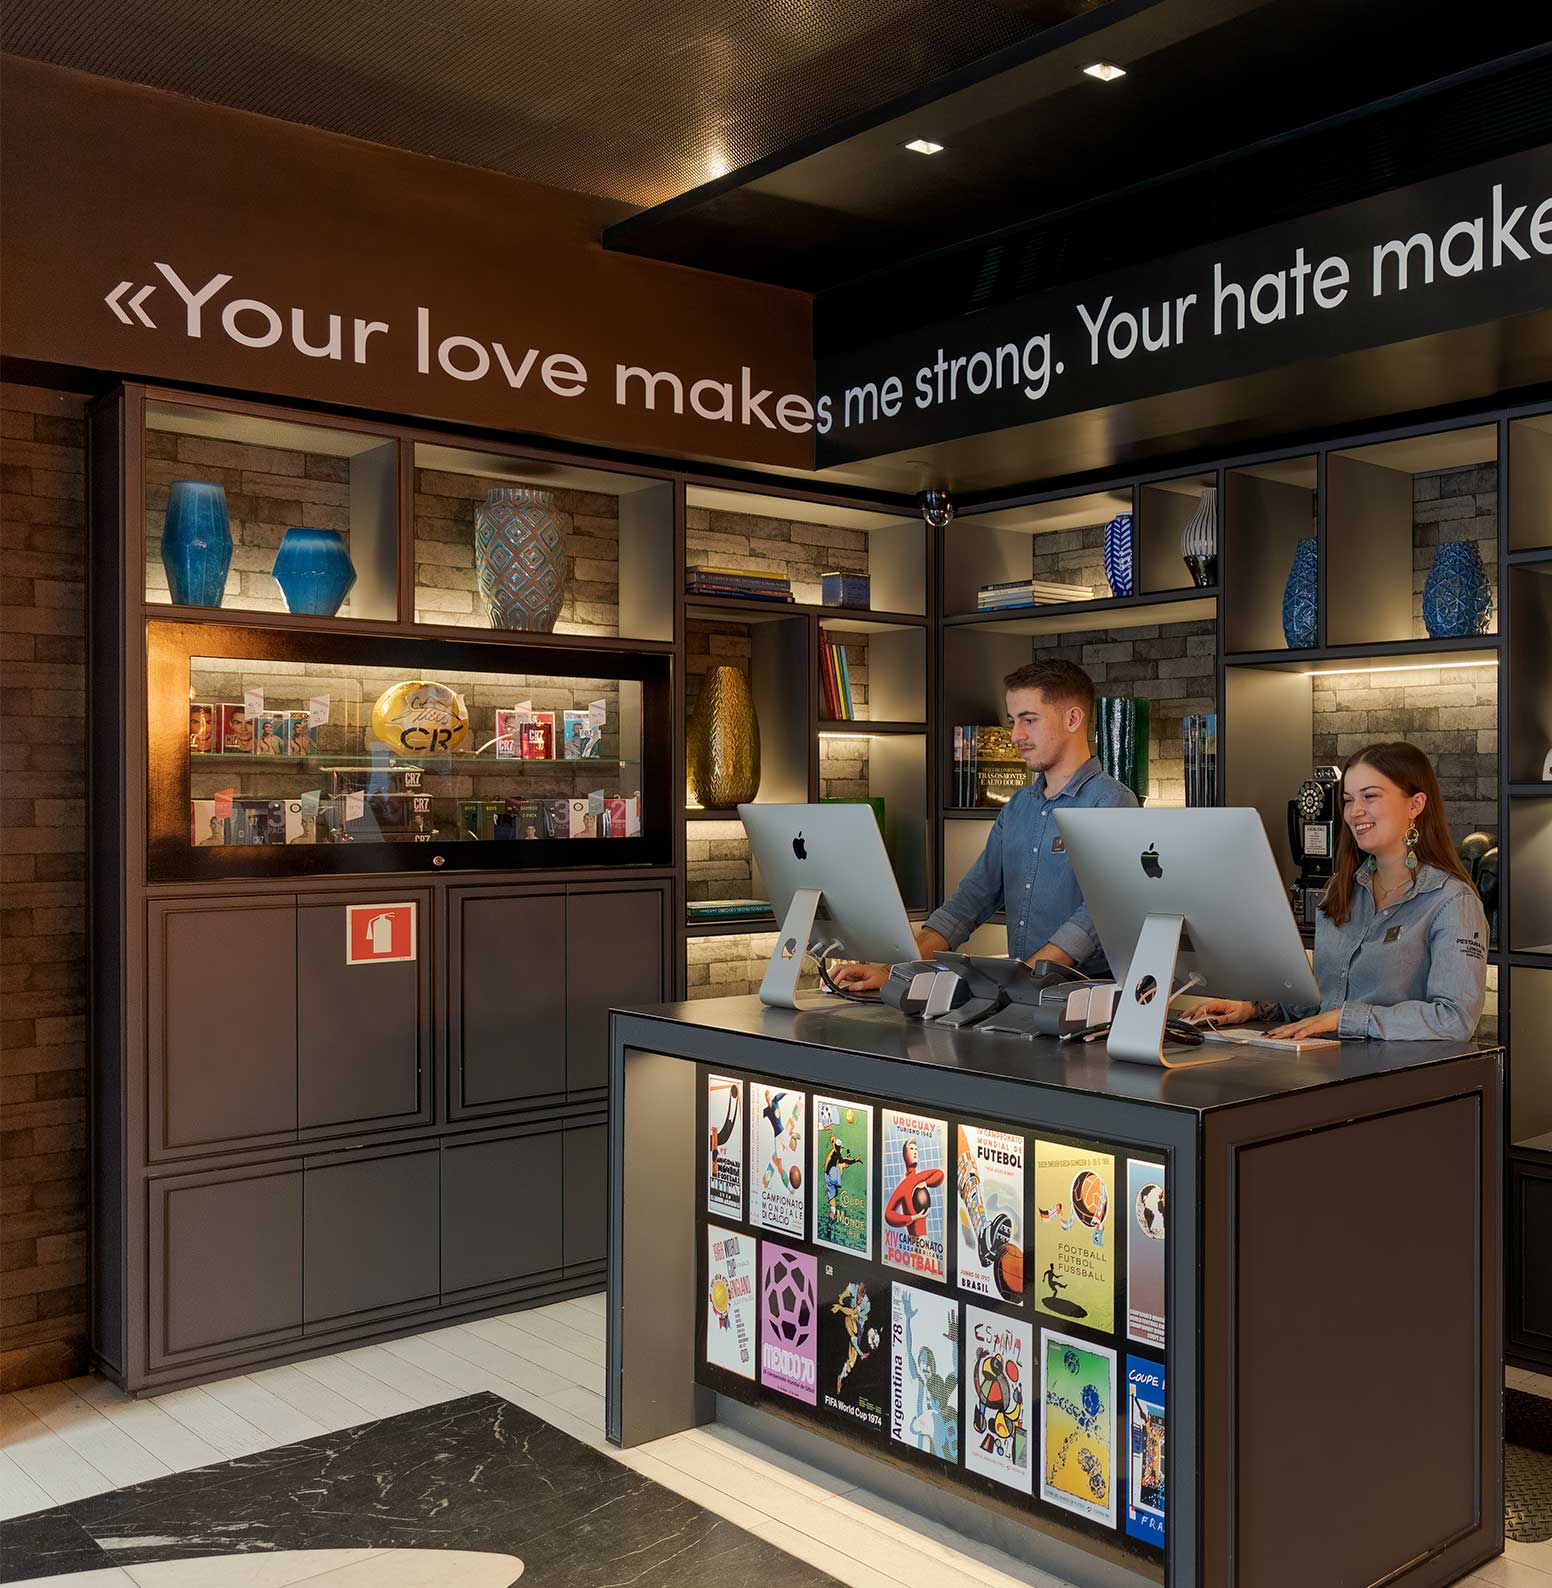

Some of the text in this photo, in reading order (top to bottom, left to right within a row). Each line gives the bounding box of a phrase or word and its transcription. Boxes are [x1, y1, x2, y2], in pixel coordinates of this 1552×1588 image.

[104, 261, 390, 365] «Your
[417, 306, 587, 397] love
[615, 364, 834, 434] makes
[844, 376, 903, 428] me
[915, 333, 1065, 409] strong.
[1077, 293, 1197, 366] Your
[1214, 247, 1350, 336] hate
[405, 772, 421, 785] CR7
[413, 798, 430, 811] CR7
[611, 800, 626, 823] 2
[893, 1115, 936, 1133] URUGUAY
[977, 1136, 1010, 1152] MUNDIAL
[984, 1129, 1023, 1145] CAMPEONATO
[977, 1145, 1023, 1169] FUTEBOL
[762, 1191, 803, 1210] CAMPIONATO
[762, 1201, 803, 1220] MONDIALE
[768, 1211, 790, 1226] CALCIO
[885, 1229, 944, 1254] XIV CAMPEONATO
[887, 1247, 944, 1276] FOOTBALL
[1058, 1242, 1107, 1262] FOOTBALL
[1058, 1253, 1094, 1269] FUTBOL
[1058, 1263, 1105, 1282] FUSSBALL
[961, 1277, 989, 1293] BRASIL
[974, 1323, 1023, 1368] ESPAÑA
[1129, 1369, 1159, 1388] COUPE
[892, 1356, 904, 1440] Argentina
[825, 1395, 838, 1408] FIFA
[838, 1400, 855, 1415] World
[855, 1407, 867, 1421] Cup
[867, 1412, 882, 1427] 1974
[1140, 1515, 1165, 1533] FRA
